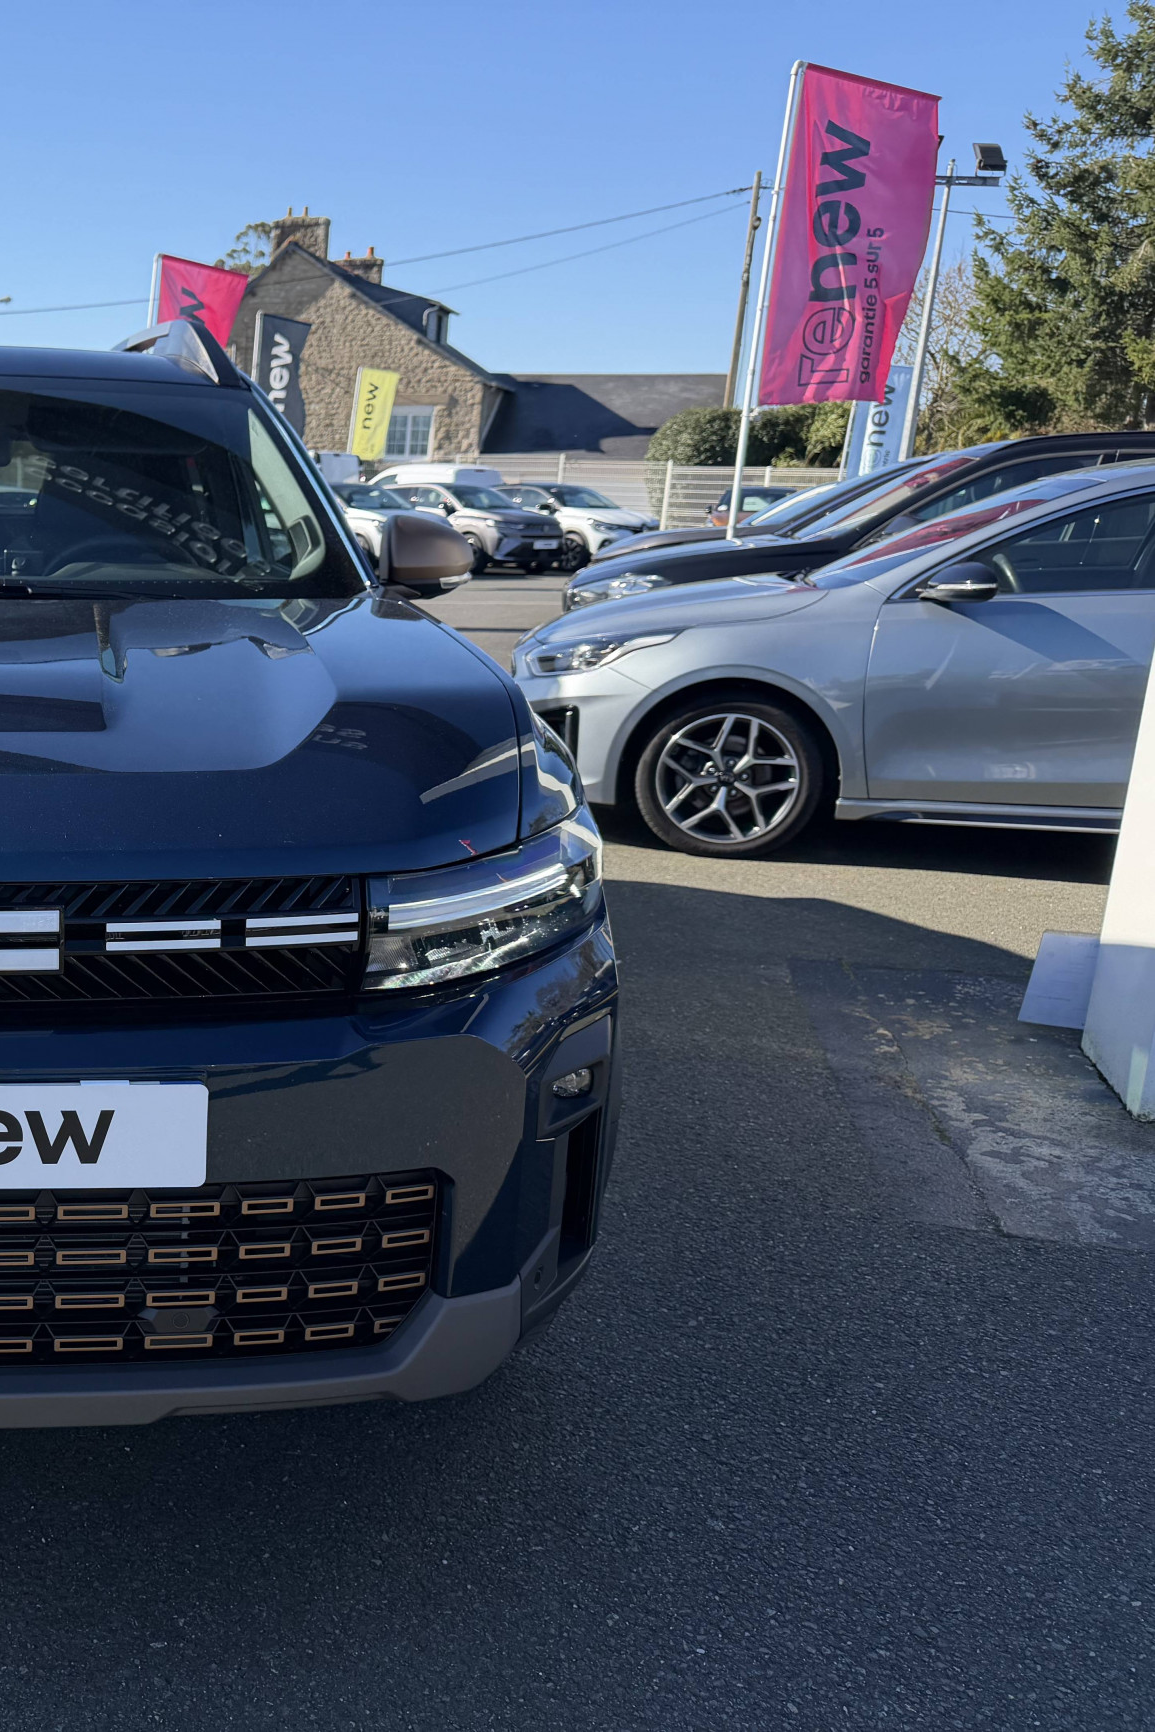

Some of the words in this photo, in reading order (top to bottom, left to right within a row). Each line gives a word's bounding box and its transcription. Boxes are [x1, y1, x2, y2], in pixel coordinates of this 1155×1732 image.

[866, 227, 885, 241] 5
[797, 119, 871, 388] renew
[866, 241, 882, 274] sur
[864, 278, 879, 290] 5
[858, 295, 878, 384] garantie
